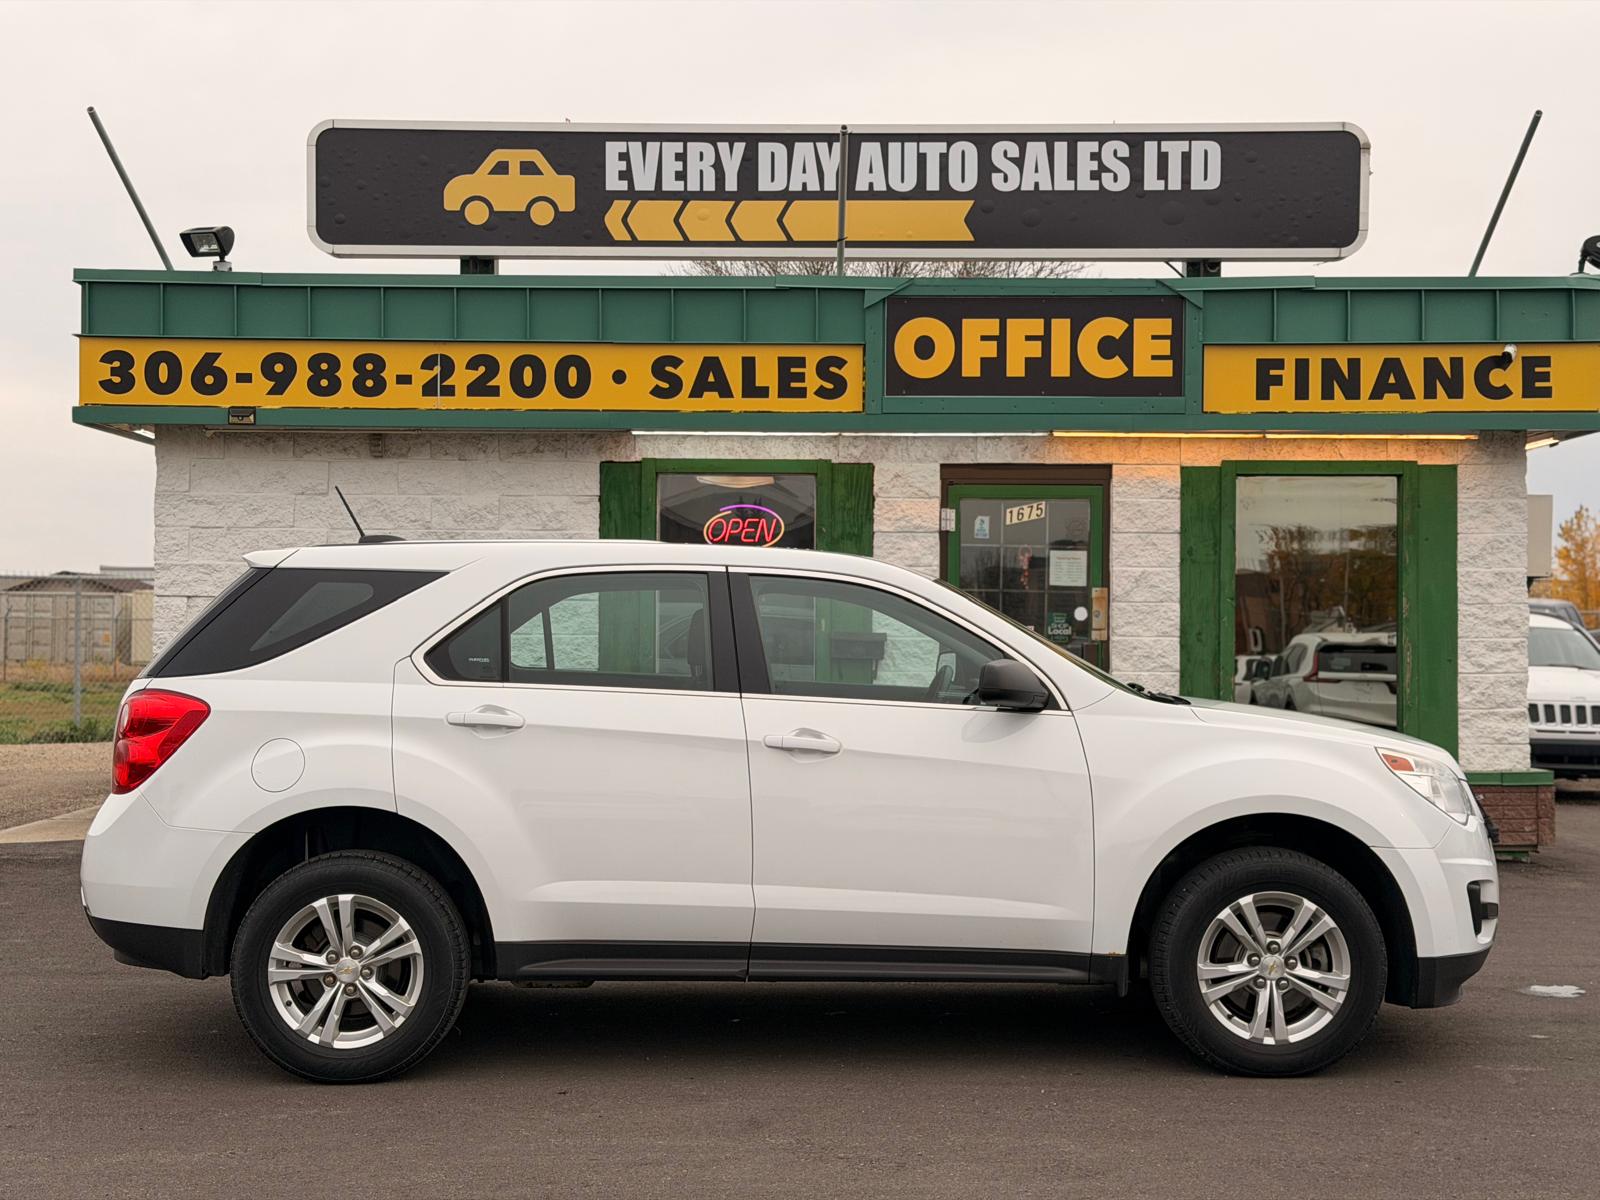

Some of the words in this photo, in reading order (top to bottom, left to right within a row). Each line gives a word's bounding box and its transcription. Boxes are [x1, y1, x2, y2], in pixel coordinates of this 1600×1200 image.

[605, 141, 746, 192] EVERY
[757, 141, 841, 192] DAY
[854, 141, 978, 193] AUTO
[991, 140, 1131, 193] SALES
[1143, 140, 1222, 192] LTD
[893, 316, 1174, 380] OFFICE
[98, 350, 591, 398] 306-988-2200
[649, 355, 848, 400] SALES
[1255, 356, 1553, 401] FINANCE
[708, 518, 777, 542] OPEN
[1007, 502, 1044, 523] 1675
[1048, 625, 1072, 635] Local
